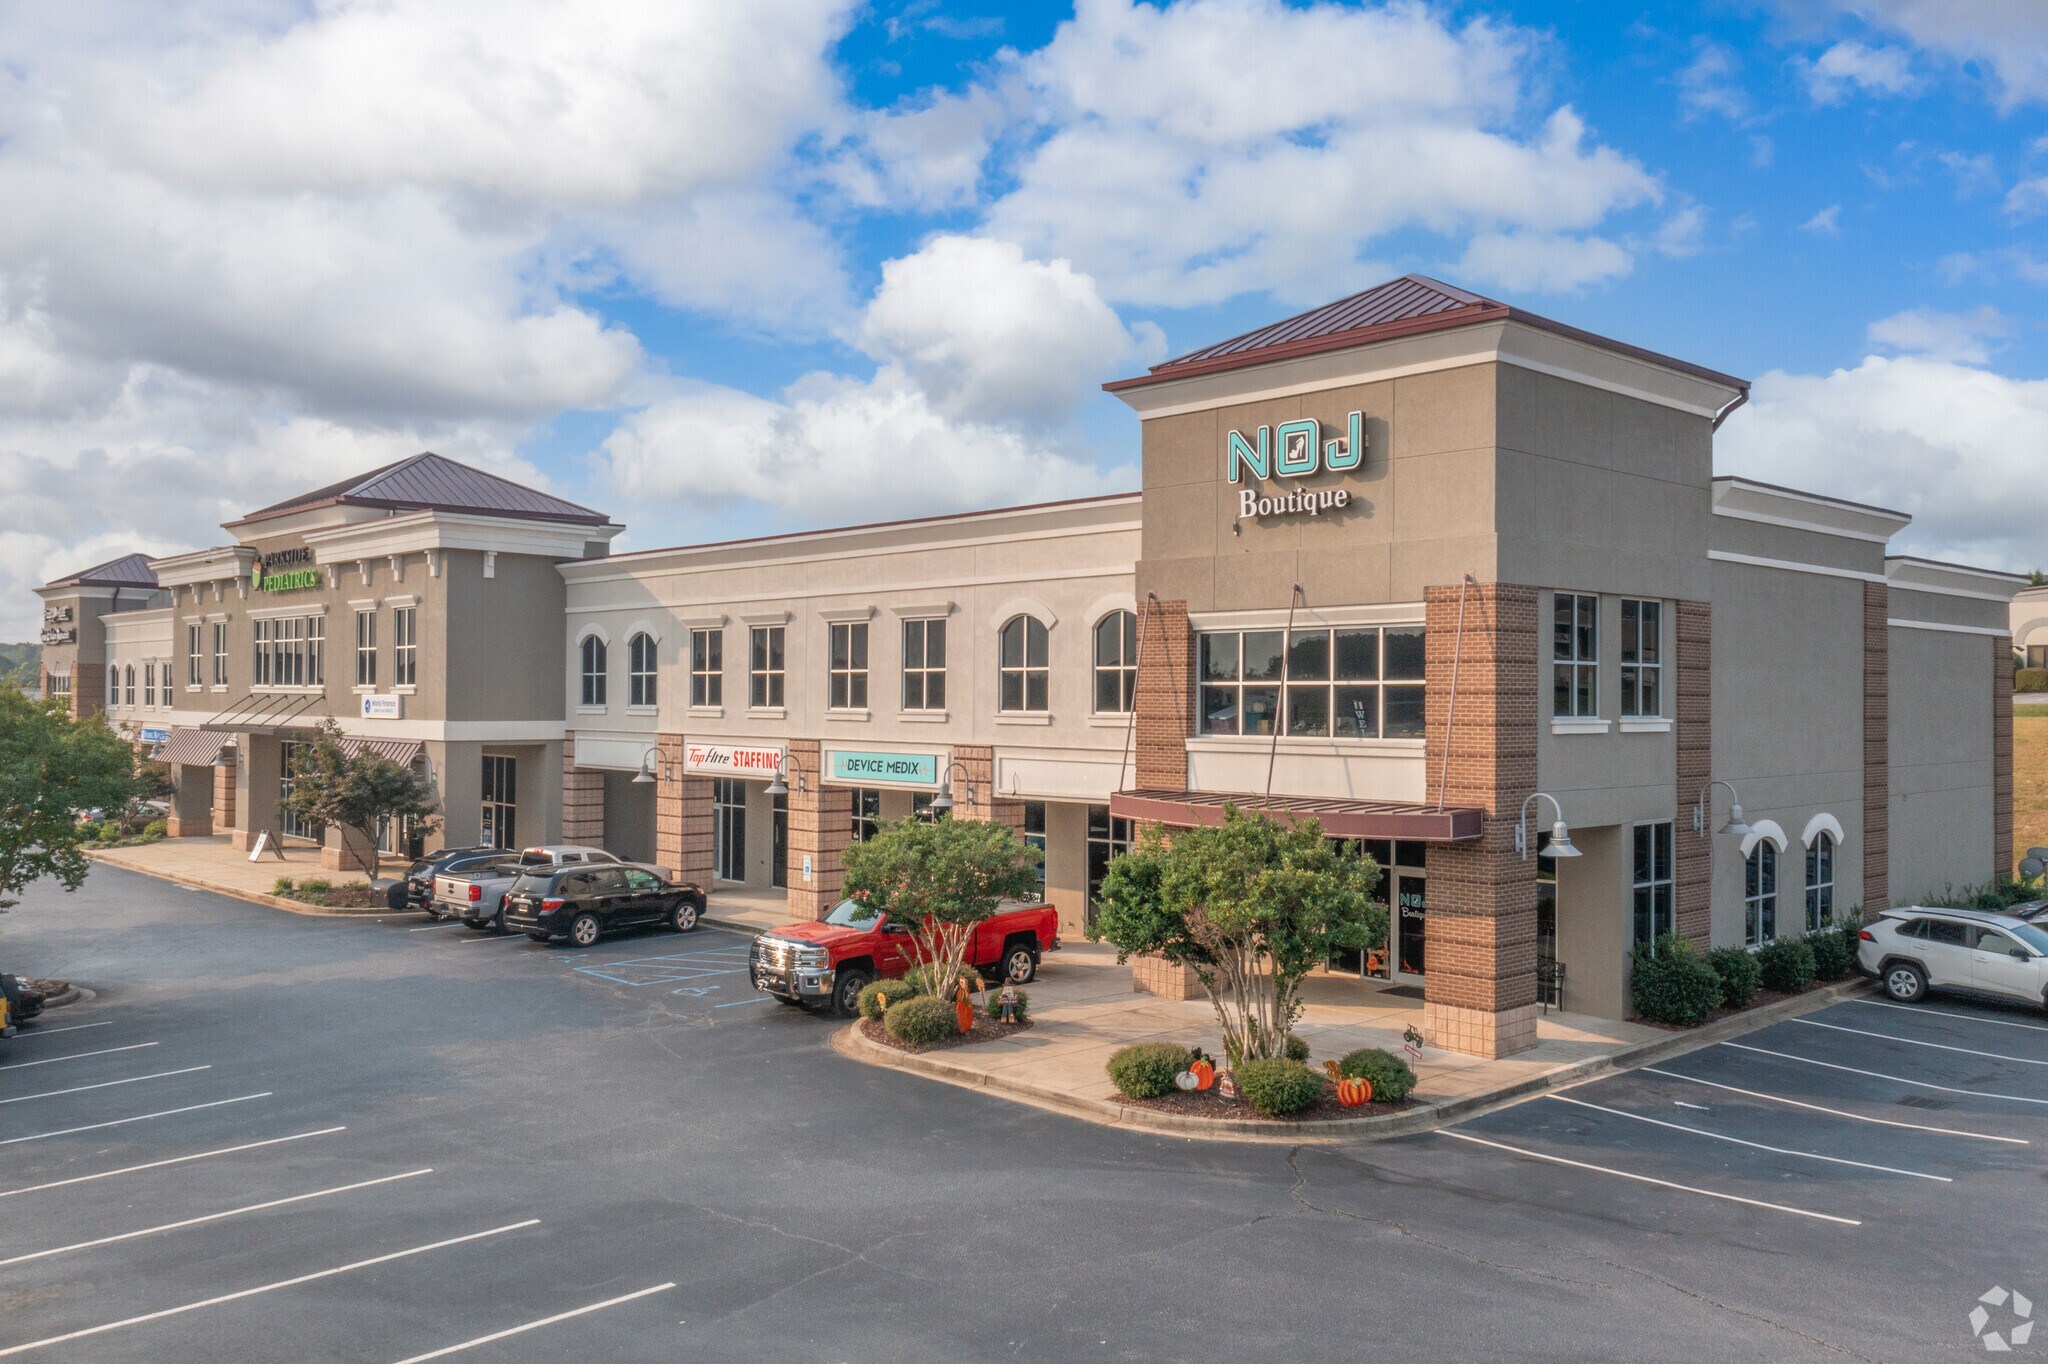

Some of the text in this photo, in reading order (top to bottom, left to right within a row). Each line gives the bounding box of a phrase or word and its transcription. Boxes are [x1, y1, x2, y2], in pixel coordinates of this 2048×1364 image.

[1228, 410, 1367, 484] NOJ
[1238, 487, 1350, 519] Boutique
[263, 569, 318, 593] PEDIATRICS
[733, 750, 780, 770] STAFFING
[847, 758, 920, 775] DEVICE MEDIX
